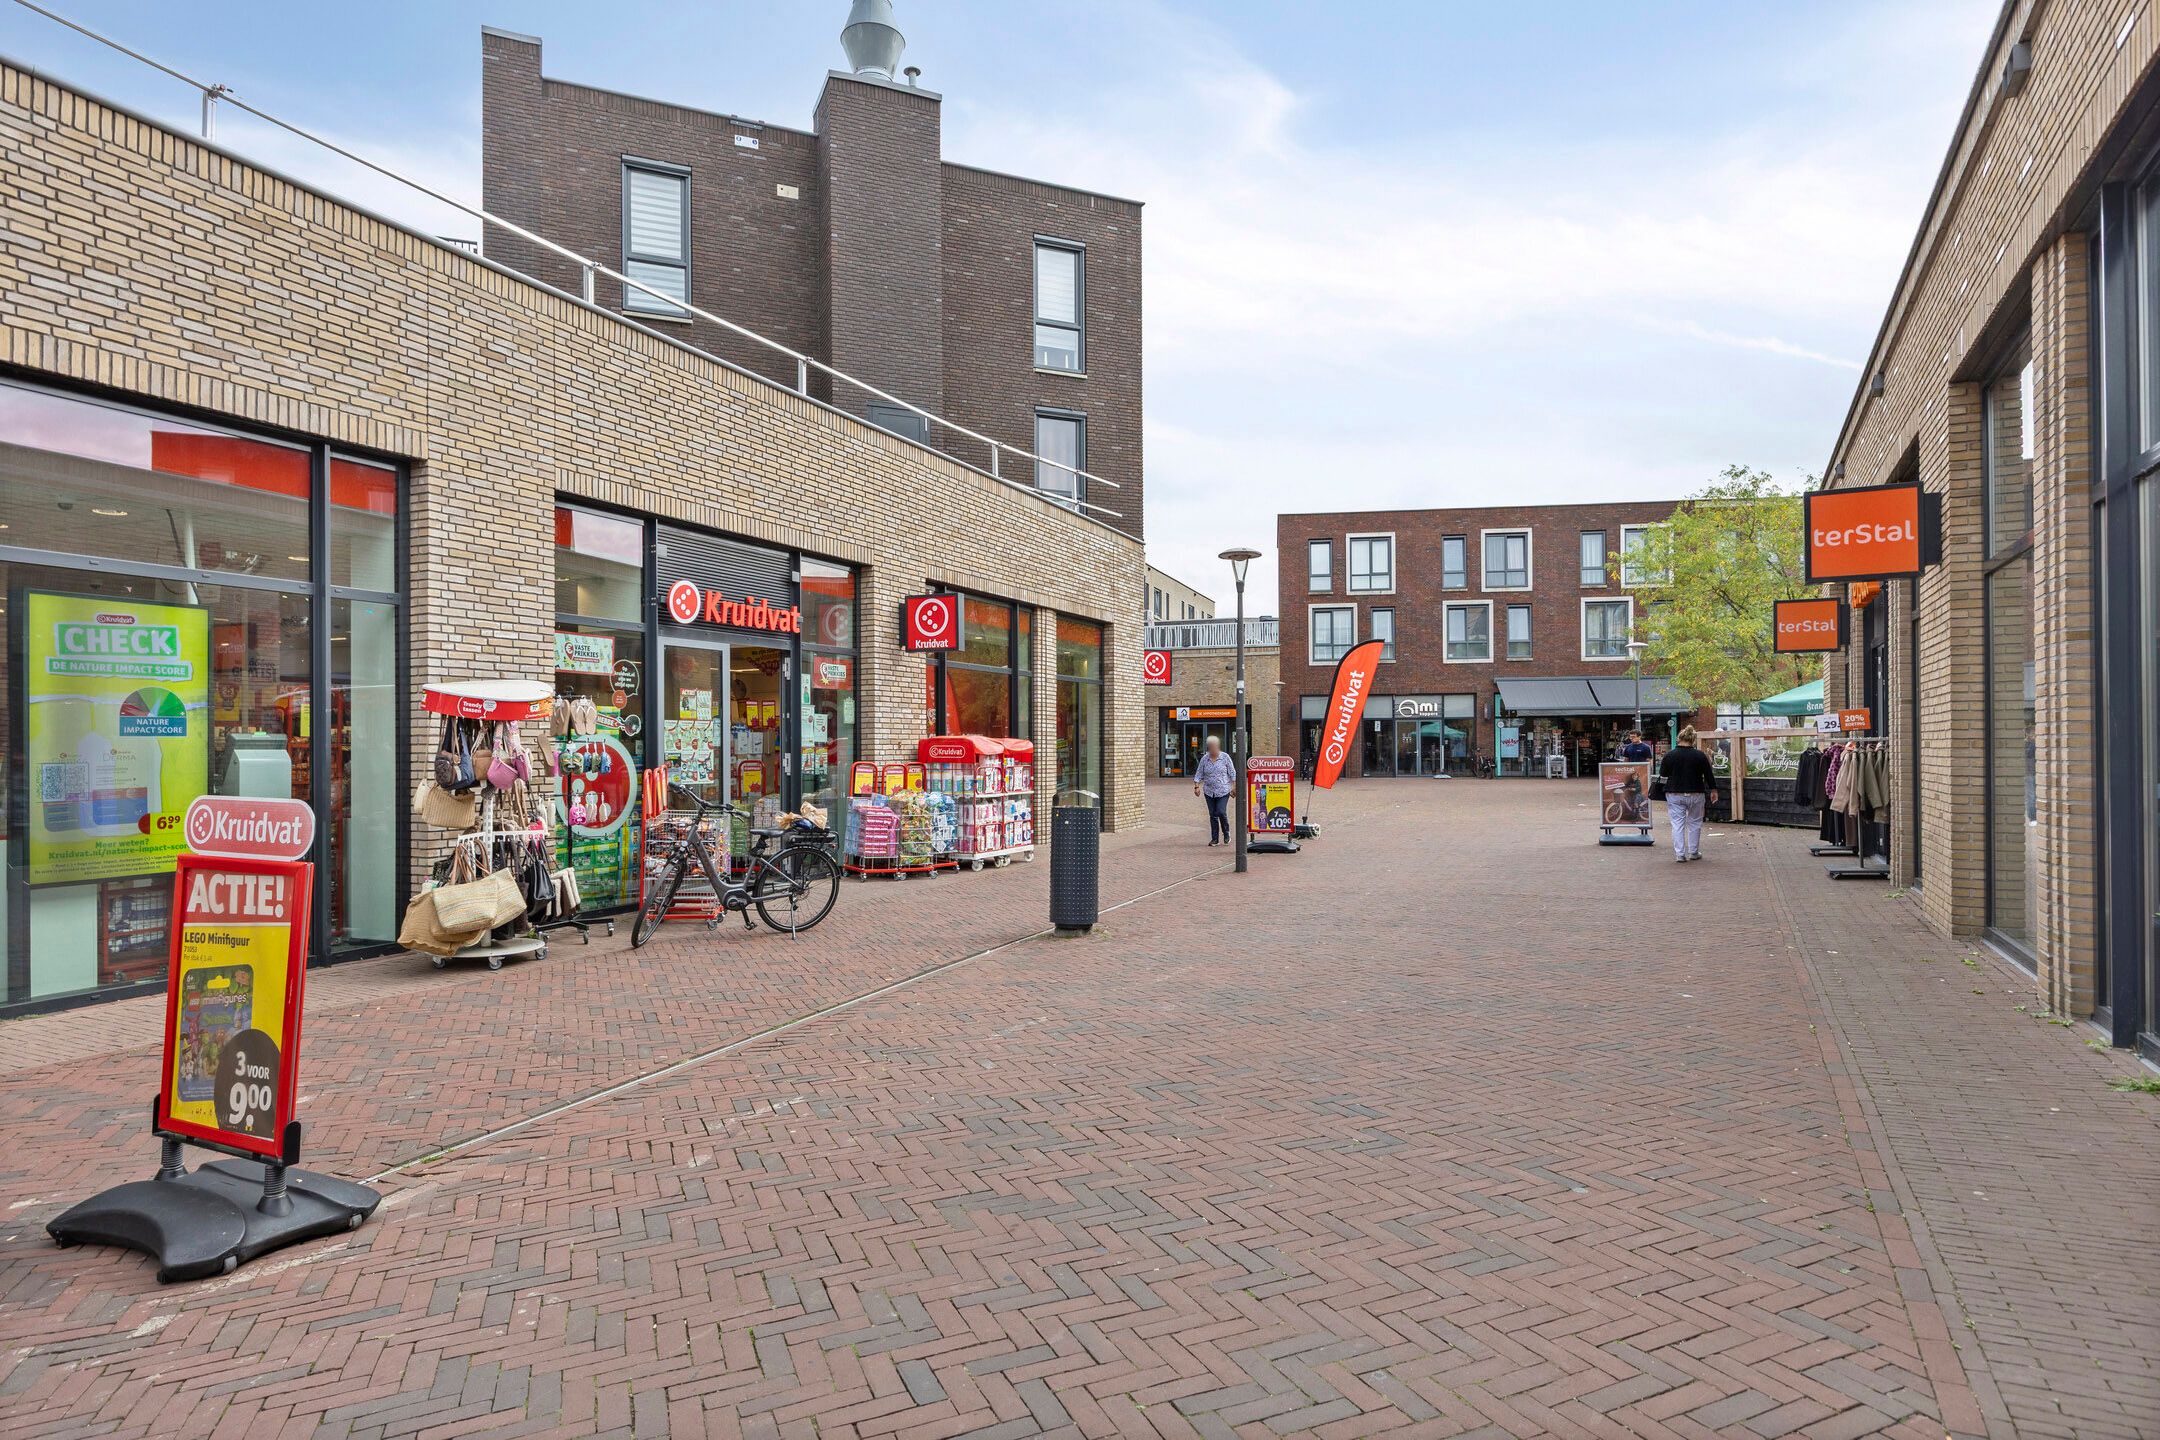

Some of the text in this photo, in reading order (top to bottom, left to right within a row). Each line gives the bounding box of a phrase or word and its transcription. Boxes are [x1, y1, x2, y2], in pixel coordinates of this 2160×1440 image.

[1814, 520, 1914, 548] terStal
[703, 588, 800, 634] Kruidvat
[1778, 618, 1836, 633] terStal
[64, 626, 174, 654] CHECK
[915, 638, 949, 649] Kruidvat
[574, 644, 591, 652] VASTE
[574, 650, 599, 658] PRIKKIES
[52, 661, 186, 676] DE NATURE IMPACT SCORE
[1332, 670, 1365, 743] Kruidvat
[1844, 714, 1865, 723] 20%
[124, 726, 183, 734] IMPACT SCORE
[938, 747, 963, 756] Kruidvat
[1254, 773, 1289, 782] ACTIE!
[214, 810, 302, 845] Kruidvat
[119, 838, 149, 848] weten?
[186, 874, 285, 918] ACTIE!
[184, 932, 250, 949] LEGO Minifiguur
[235, 1051, 270, 1080] 3 VOOR
